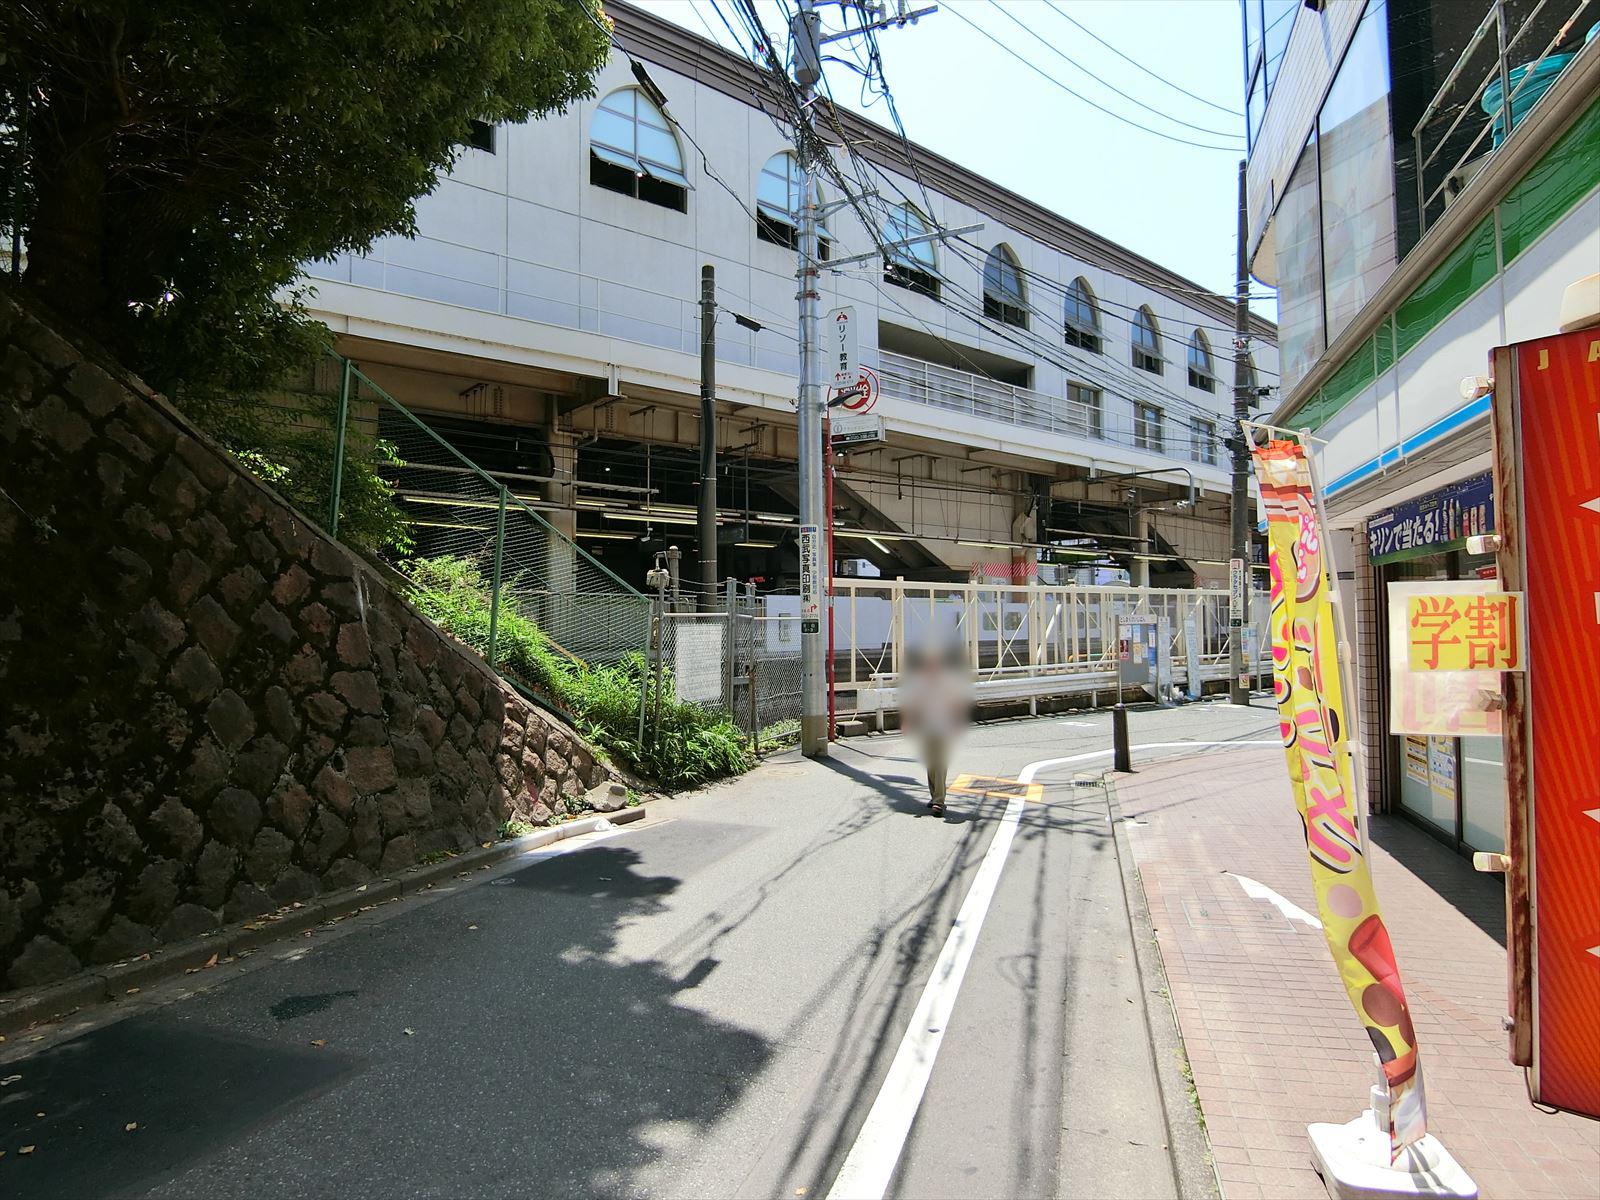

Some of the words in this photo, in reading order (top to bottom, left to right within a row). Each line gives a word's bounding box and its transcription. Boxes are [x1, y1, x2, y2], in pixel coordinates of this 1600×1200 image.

[838, 325, 848, 371] リソー教育
[1411, 595, 1518, 670] 学割
